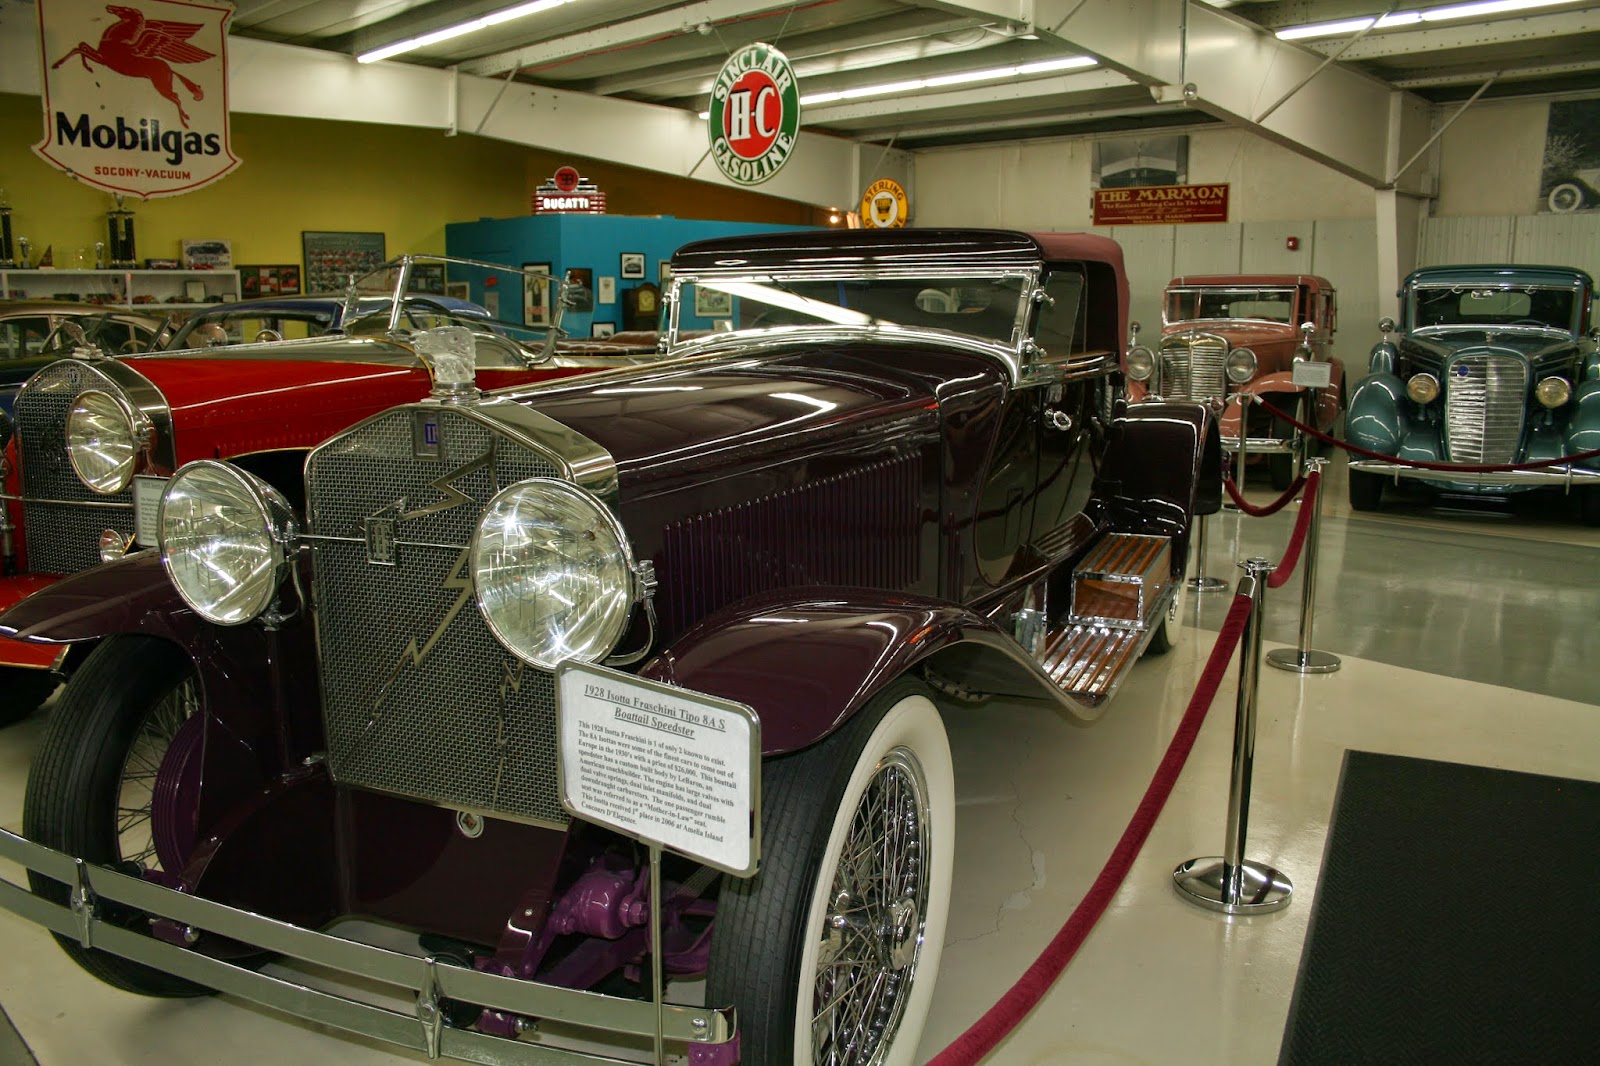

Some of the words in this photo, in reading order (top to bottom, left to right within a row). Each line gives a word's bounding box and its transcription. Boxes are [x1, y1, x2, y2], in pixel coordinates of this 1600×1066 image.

[715, 49, 792, 102] SINCLAIR
[56, 111, 220, 166] Mobilgas
[714, 132, 793, 181] GASOLINE
[94, 166, 191, 180] SOCONY-VACUUM
[864, 181, 904, 203] STERLING
[543, 198, 589, 209] BUGATTI
[1099, 191, 1130, 202] THE
[1136, 187, 1225, 200] MARMON
[584, 684, 604, 698] 1928
[607, 690, 630, 705] Isotta
[633, 697, 676, 717] Fraschini
[679, 708, 699, 723] Tipo
[614, 706, 649, 725] Boattail
[651, 716, 694, 737] Speedster
[578, 720, 590, 729] This
[591, 723, 603, 733] 1928
[604, 727, 619, 737] Isotta
[621, 731, 646, 745] Fraschini
[647, 738, 652, 746] is
[665, 745, 677, 754] only
[683, 748, 702, 760] known
[703, 754, 710, 762] to
[578, 729, 589, 738] The
[598, 735, 616, 746] Isottas
[617, 741, 630, 750] were
[631, 745, 645, 754] some
[646, 748, 653, 756] of
[653, 750, 662, 758] the
[663, 752, 679, 763] finest
[680, 759, 692, 767] cars
[693, 761, 699, 769] to
[700, 764, 715, 773] come
[716, 768, 726, 776] out
[727, 770, 734, 779] of
[578, 739, 597, 750] Europe
[605, 746, 614, 754] the
[633, 754, 646, 763] with
[651, 760, 666, 769] price
[667, 763, 673, 771] of
[700, 772, 712, 782] This
[713, 776, 736, 789] boattail
[578, 749, 602, 760] speedster
[603, 755, 613, 763] has
[619, 760, 638, 770] custom
[640, 765, 653, 775] built
[654, 769, 668, 780] body
[669, 773, 676, 783] by
[579, 757, 605, 769] American
[644, 775, 654, 783] The
[655, 780, 674, 790] engine
[675, 784, 685, 792] has
[686, 787, 700, 797] large
[701, 793, 719, 803] valves
[720, 797, 734, 807] with
[580, 765, 591, 774] dual
[592, 770, 606, 779] valve
[629, 780, 641, 789] dual
[642, 784, 655, 793] inlet
[686, 797, 697, 806] and
[698, 800, 711, 810] dual
[581, 783, 591, 792] seat
[603, 791, 625, 802] referred
[581, 775, 615, 791] downdraught
[652, 795, 662, 805] The
[664, 800, 674, 808] one
[675, 804, 703, 817] passenger
[704, 812, 725, 824] rumble
[581, 801, 605, 814] Concours
[581, 792, 592, 801] This
[593, 796, 608, 806] Isotta
[609, 801, 631, 813] received
[639, 811, 653, 821] place
[654, 815, 660, 823] in
[661, 817, 675, 827] 2006
[676, 822, 682, 830] at
[682, 824, 703, 836] Amelia
[704, 831, 723, 843] Island
